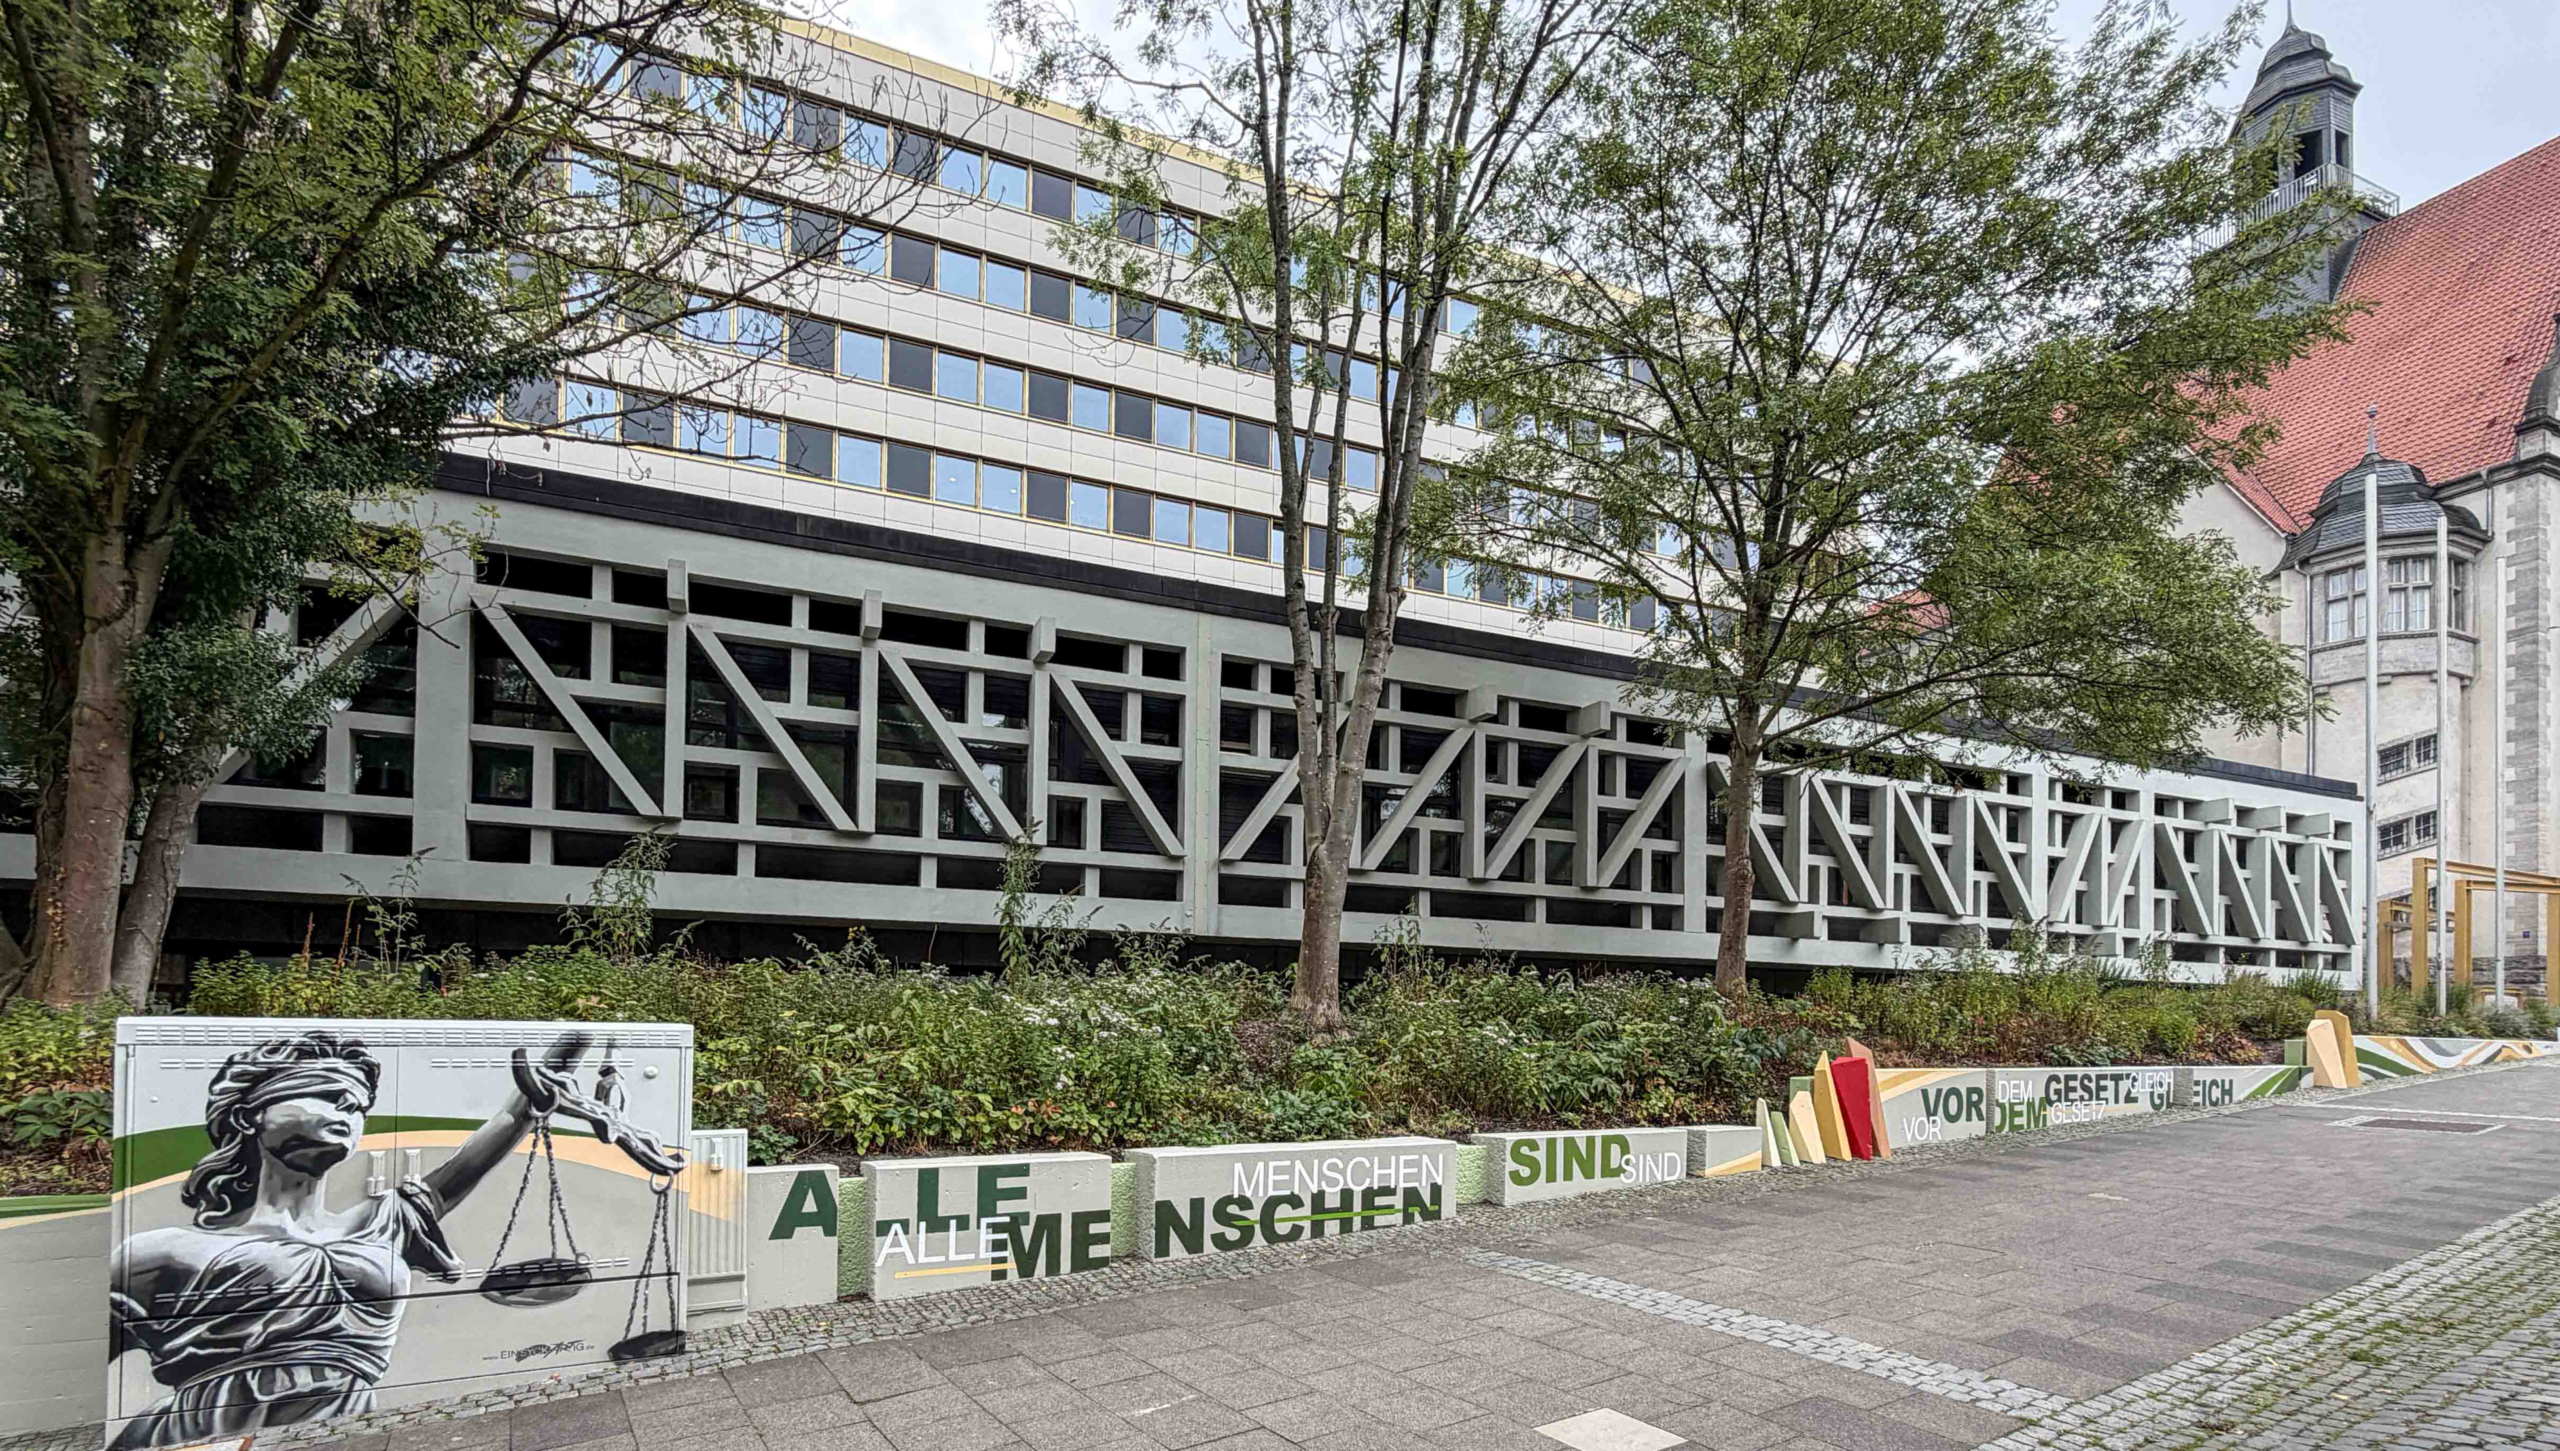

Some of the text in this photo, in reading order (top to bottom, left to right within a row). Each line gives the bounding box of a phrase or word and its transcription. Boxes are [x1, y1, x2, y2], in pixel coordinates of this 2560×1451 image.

[876, 1216, 1010, 1266] ALLE
[1233, 1153, 1443, 1198] MENSCHEN
[1620, 1152, 1681, 1183] SIND
[1903, 1117, 1941, 1141] VOR
[1999, 1080, 2033, 1102] DEM
[2129, 1072, 2174, 1092] GLEICH
[1509, 1134, 1631, 1186] SIND
[1921, 1087, 1985, 1123] VOR
[2045, 1073, 2139, 1107] GESETZ
